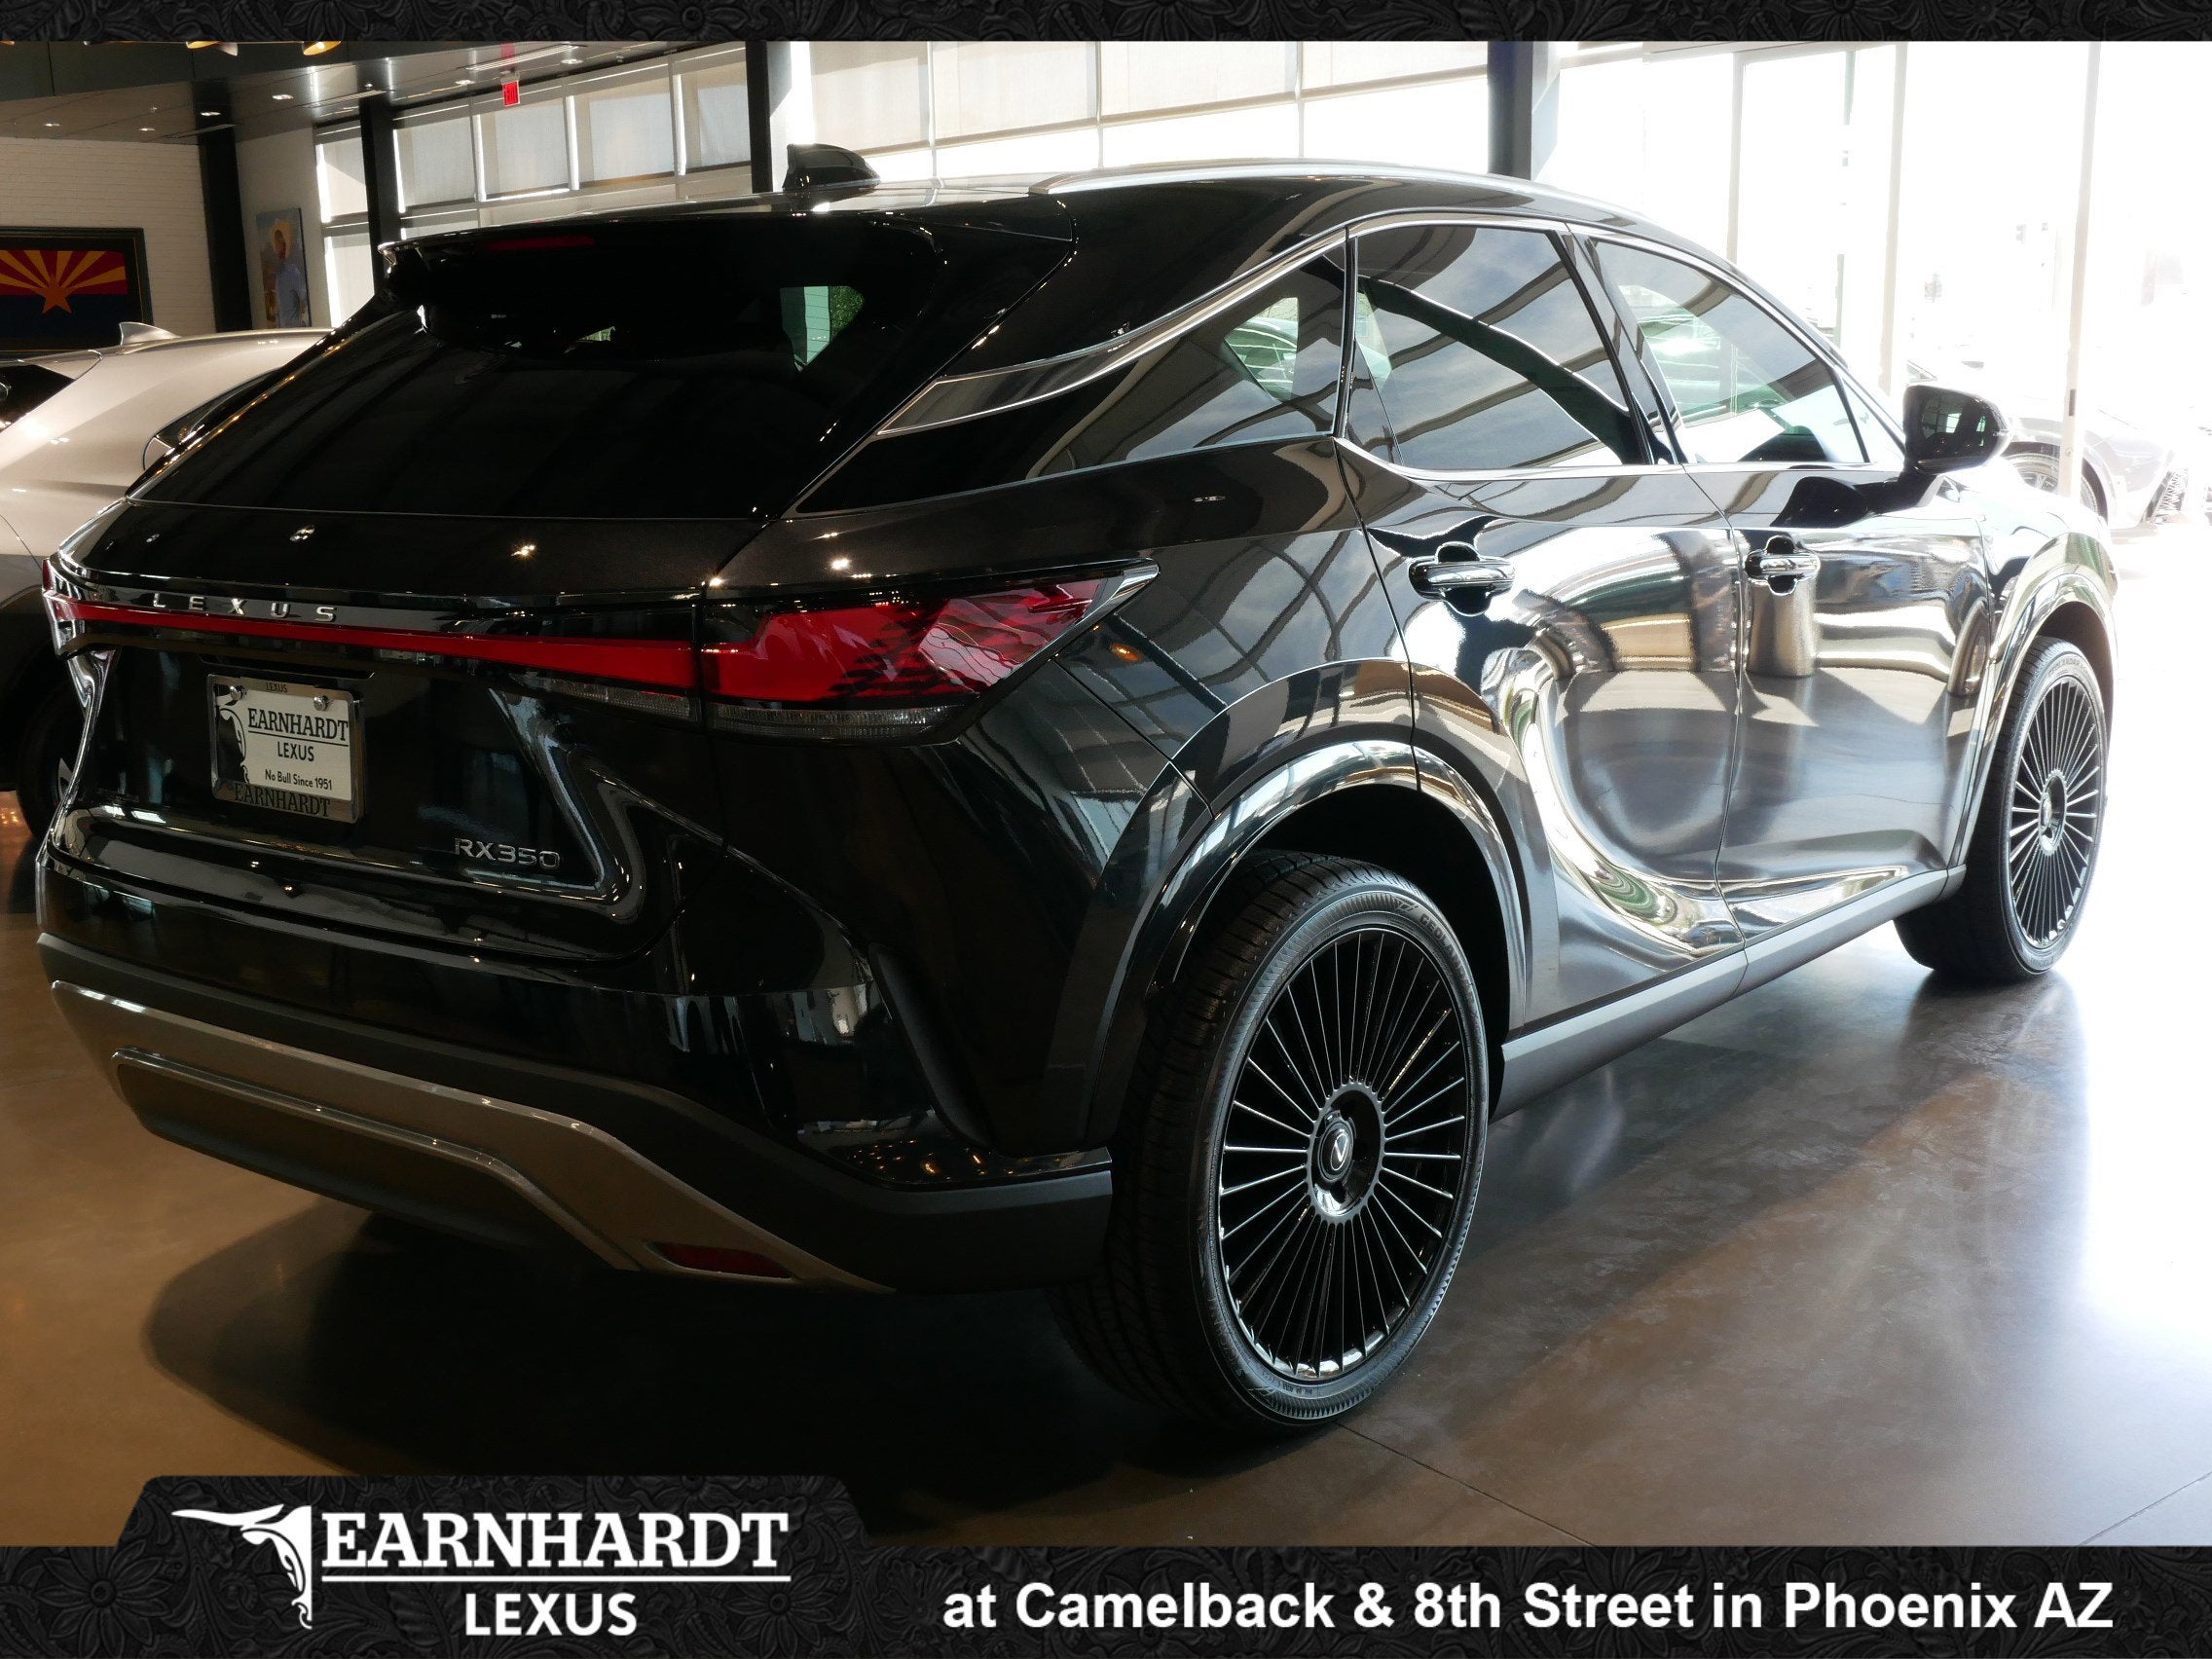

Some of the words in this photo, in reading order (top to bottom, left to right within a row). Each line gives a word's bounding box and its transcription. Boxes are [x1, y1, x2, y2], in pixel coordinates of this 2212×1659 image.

[153, 592, 336, 622] LEXUS
[266, 682, 288, 693] LEXUS
[247, 707, 349, 741] EARNHARDT
[276, 740, 315, 762] LEXUS
[265, 768, 276, 781] No
[277, 771, 291, 784] Bull
[293, 774, 313, 788] Since
[314, 777, 332, 791] 1951
[234, 782, 331, 818] EARNHARDT
[454, 837, 561, 869] RX350
